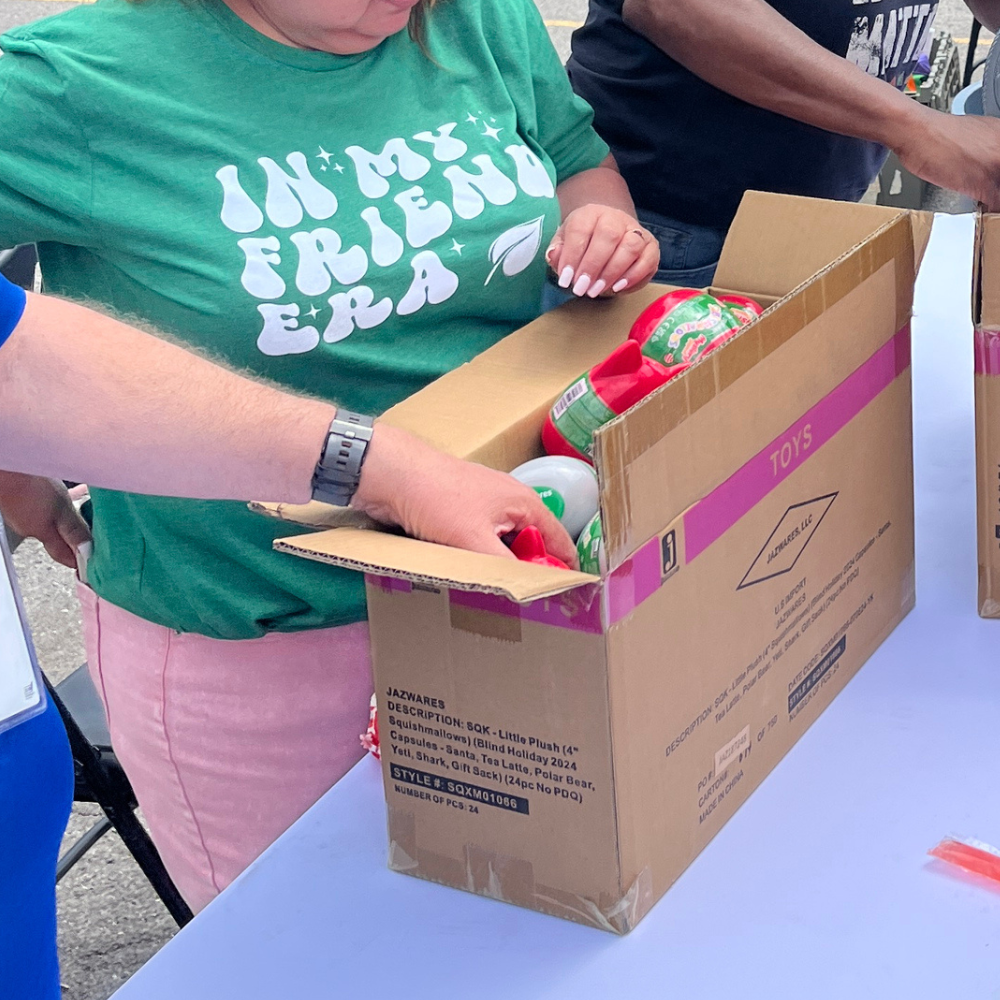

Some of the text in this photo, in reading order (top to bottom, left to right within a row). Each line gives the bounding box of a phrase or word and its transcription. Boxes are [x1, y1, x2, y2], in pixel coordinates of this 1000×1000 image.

[215, 121, 470, 234] IN MY
[256, 250, 459, 356] ERA
[770, 424, 812, 477] TOYS
[802, 514, 813, 531] LLC
[386, 687, 445, 710] JAZWARES
[387, 700, 464, 729] DESCRIPTION:
[467, 721, 490, 735] SQK
[498, 729, 526, 745] Little
[528, 736, 560, 753] Plush
[562, 745, 579, 756] (4"
[388, 715, 577, 771] Squishmallows) (Blind Holiday 2024
[390, 730, 438, 751] Capsules
[446, 744, 479, 763] Santa,
[481, 753, 499, 767] Tea
[501, 759, 533, 776] Latte,
[534, 767, 563, 783] Polar
[566, 775, 595, 792] Bear,
[391, 743, 583, 804] Yeti, Shark, Gift Sack) (24pc No PDQ)
[394, 767, 431, 786] STYLE
[395, 784, 432, 802] NUMBER
[433, 794, 445, 805] OF
[469, 804, 479, 814] 24
[700, 799, 717, 824] MADE
[718, 790, 725, 803] IN
[725, 770, 744, 794] CHINA
